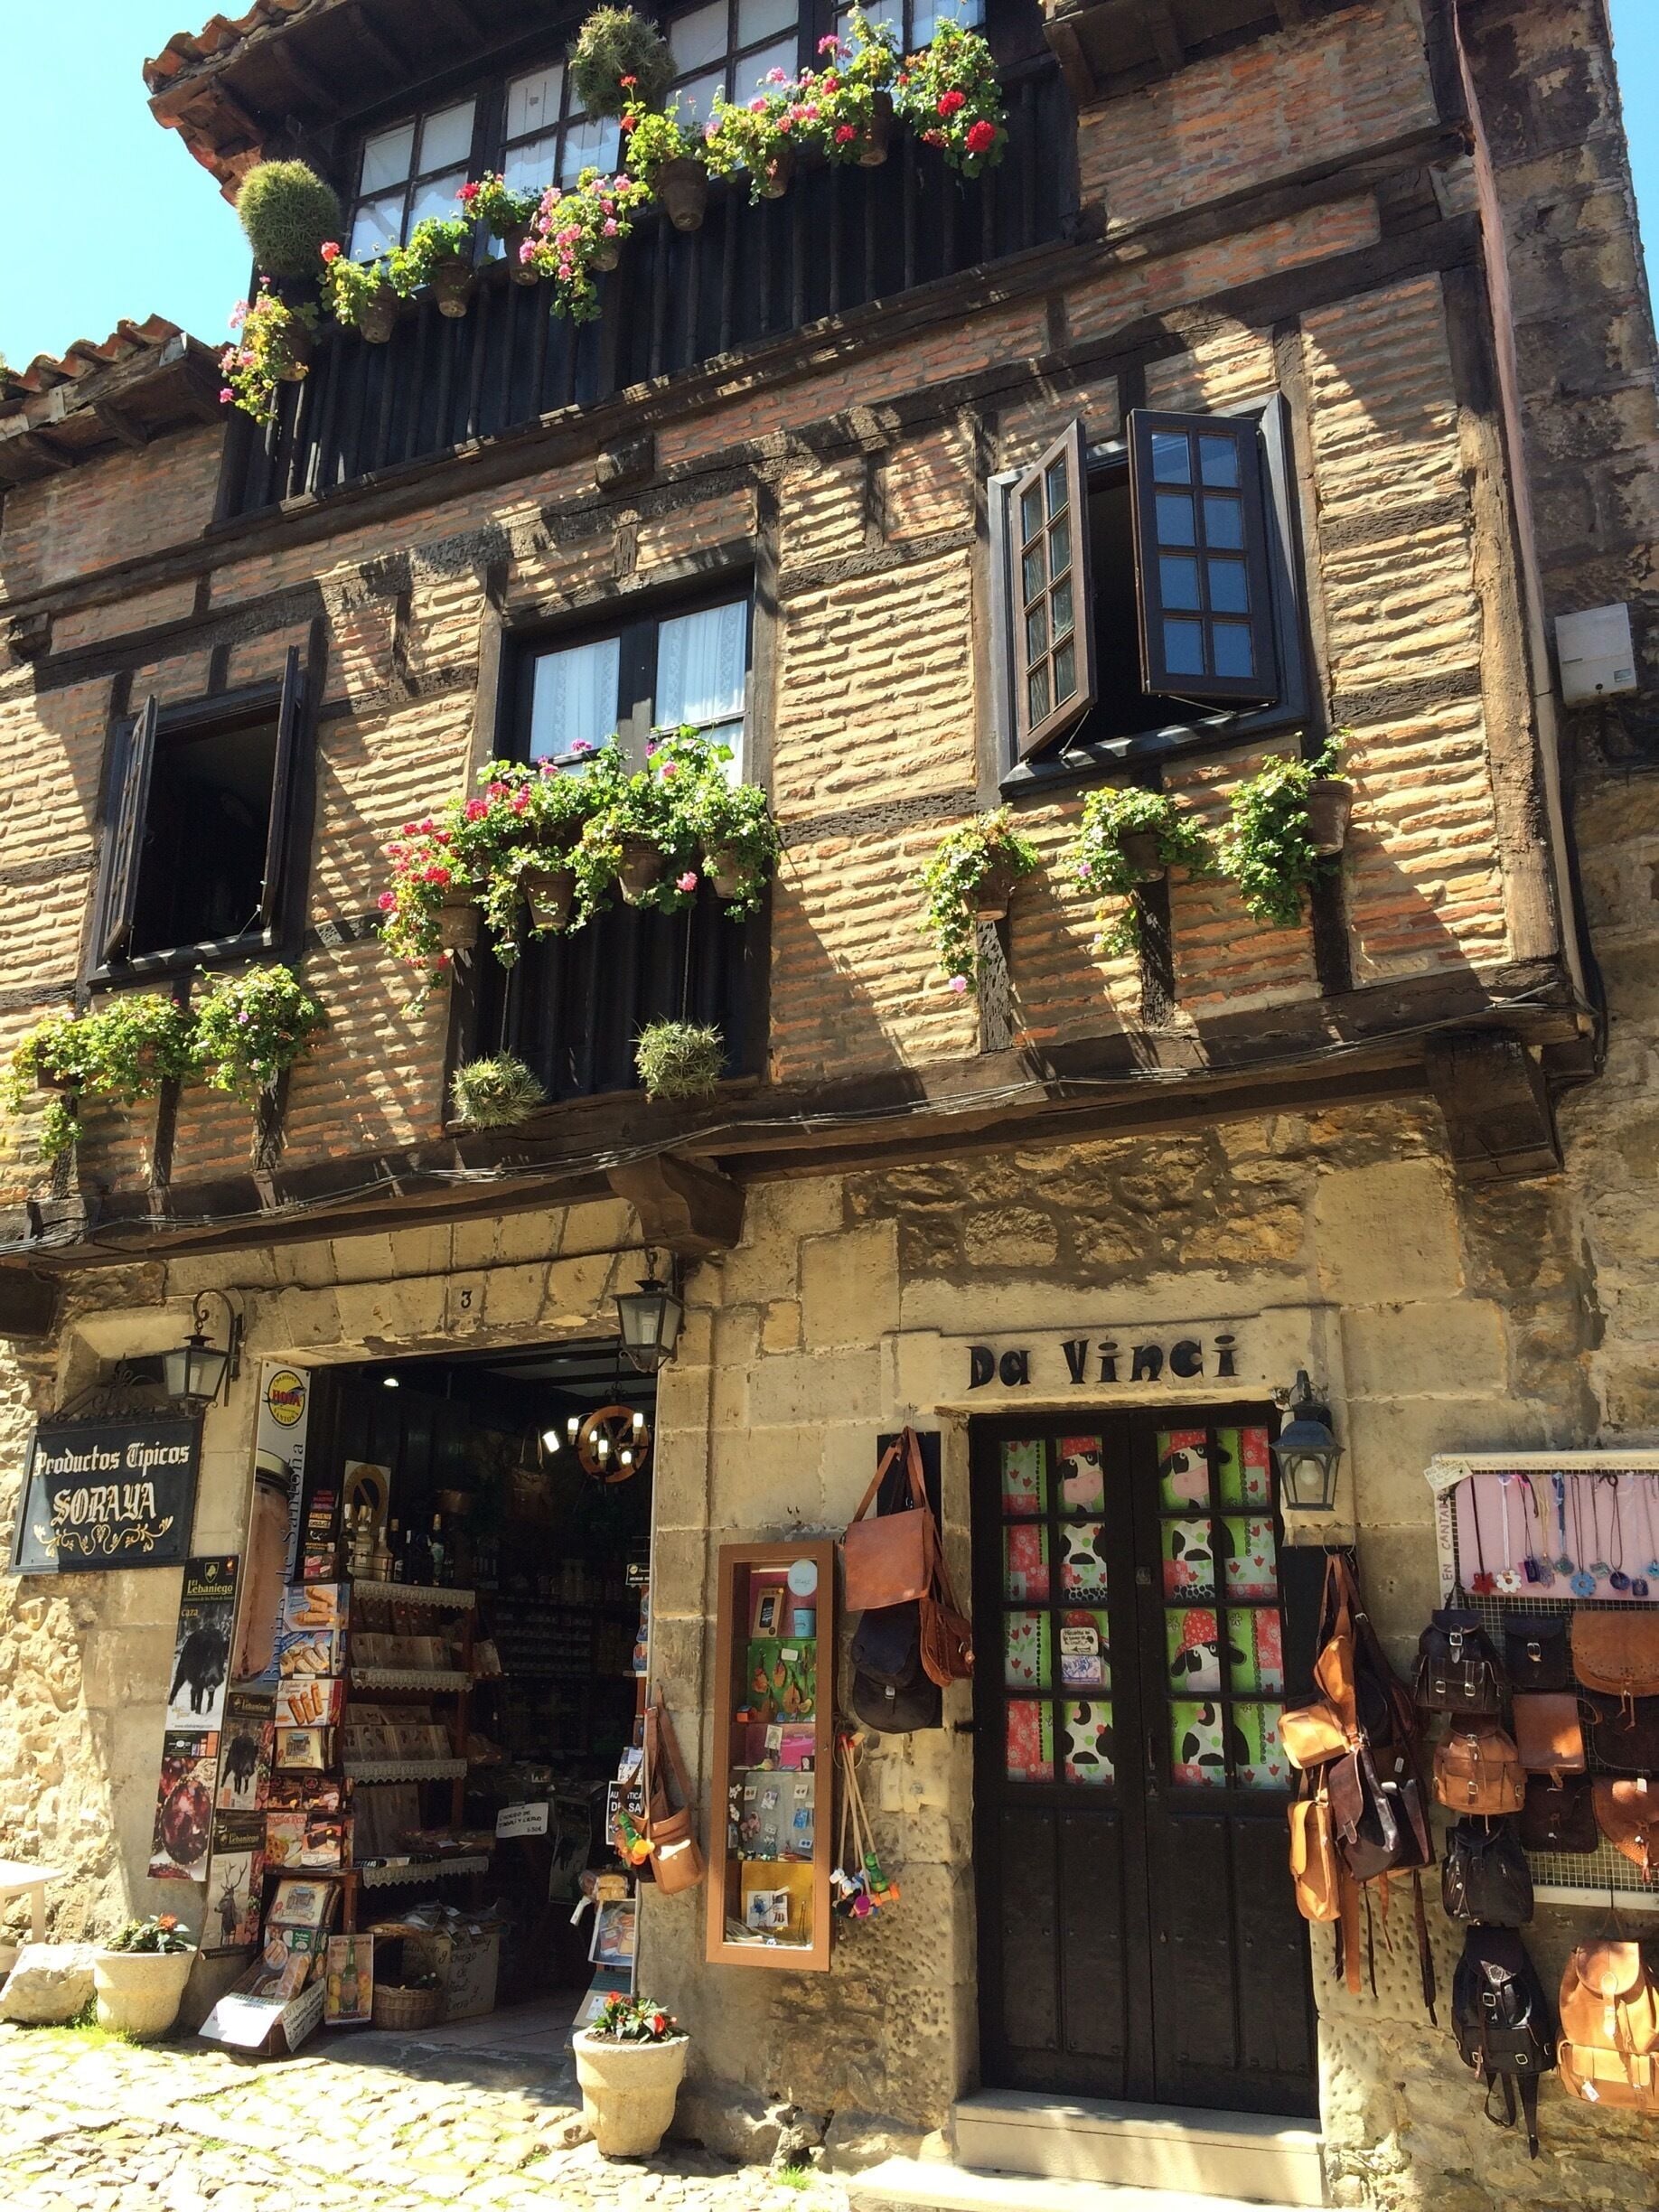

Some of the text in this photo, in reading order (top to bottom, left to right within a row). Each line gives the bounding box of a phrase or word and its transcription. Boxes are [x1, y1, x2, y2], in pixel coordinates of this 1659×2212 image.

[461, 1290, 472, 1309] 3
[964, 1335, 1242, 1390] Da Vinci
[33, 1445, 121, 1477] Productos
[282, 1443, 304, 1543] Santoña
[51, 1482, 156, 1527] SORAYA
[1442, 1563, 1453, 1581] EN
[187, 1579, 233, 1596] Lebaniego
[181, 1608, 199, 1617] caza
[610, 1791, 642, 1801] AUTICA
